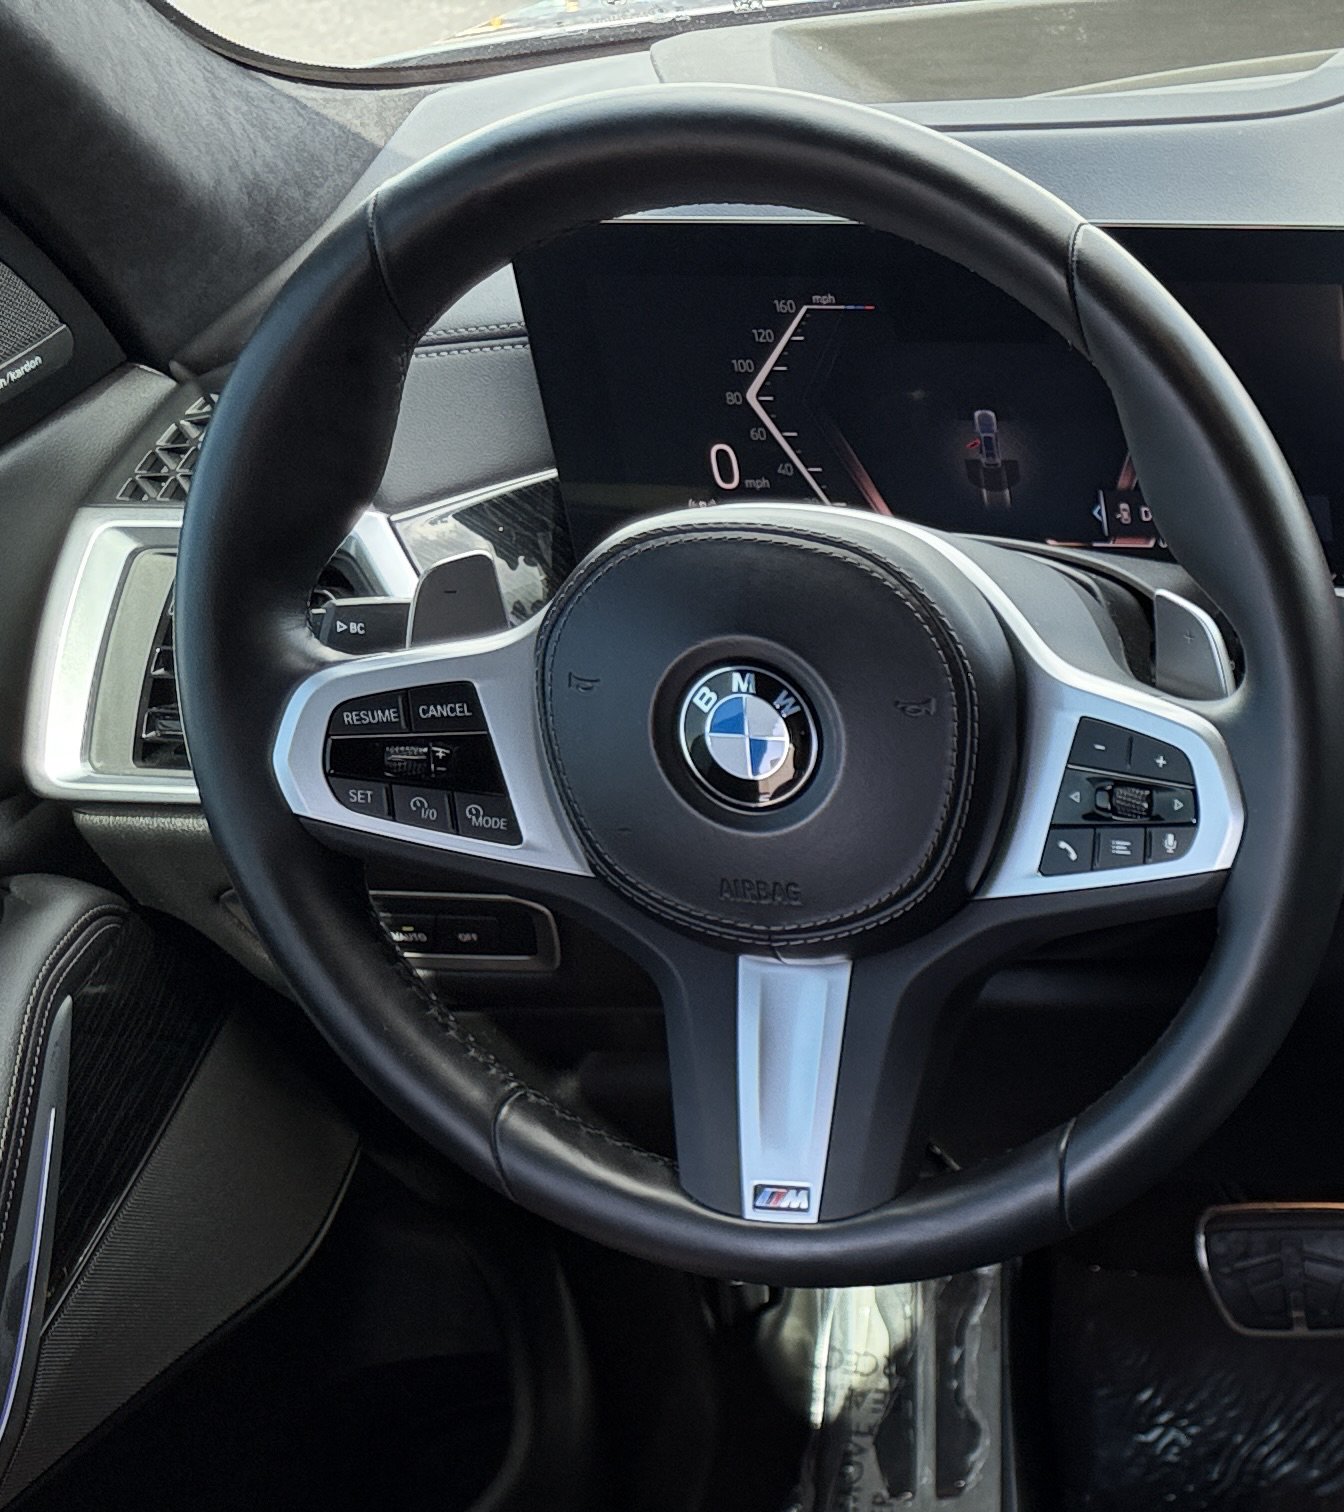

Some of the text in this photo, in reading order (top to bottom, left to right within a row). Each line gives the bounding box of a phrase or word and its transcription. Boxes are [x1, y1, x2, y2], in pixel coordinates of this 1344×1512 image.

[812, 293, 836, 304] mph
[773, 300, 796, 313] 160
[752, 329, 774, 343] 120
[732, 359, 754, 373] 100
[725, 392, 742, 405] 80
[750, 428, 767, 440] 60
[709, 443, 740, 490] 0
[777, 463, 794, 476] 40
[744, 478, 771, 490] mph
[350, 621, 366, 635] BC
[692, 671, 802, 718] BMW
[343, 708, 399, 726] RESUME
[418, 702, 473, 719] CANCEL
[348, 789, 373, 804] SET
[471, 813, 508, 831] MODE
[718, 877, 802, 902] AIRBAG
